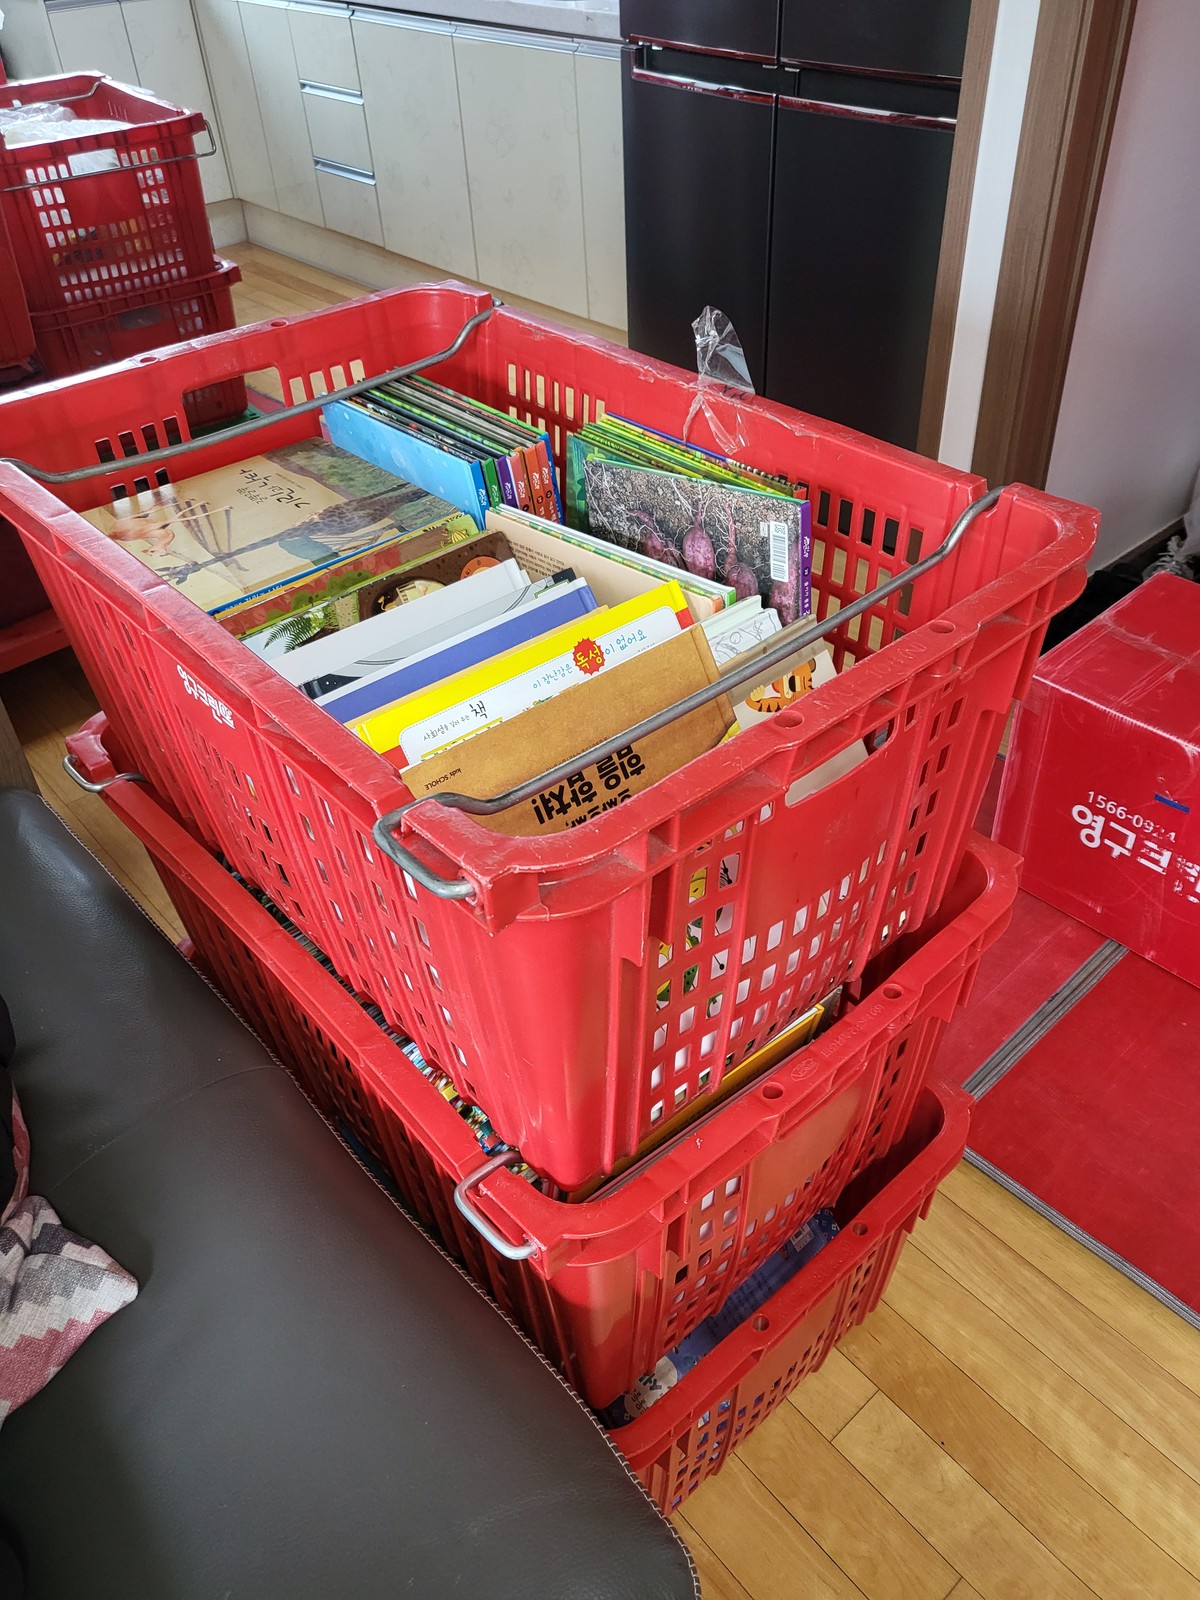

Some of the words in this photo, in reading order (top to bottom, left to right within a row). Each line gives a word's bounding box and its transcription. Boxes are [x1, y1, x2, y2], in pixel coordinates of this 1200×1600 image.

[532, 680, 542, 689] 이
[541, 663, 574, 685] 장난감은
[615, 629, 648, 651] 없어요
[468, 700, 489, 720] 책
[423, 774, 449, 791] SCHOLE
[595, 744, 647, 791] 힘을
[531, 770, 599, 825] 합쳐!
